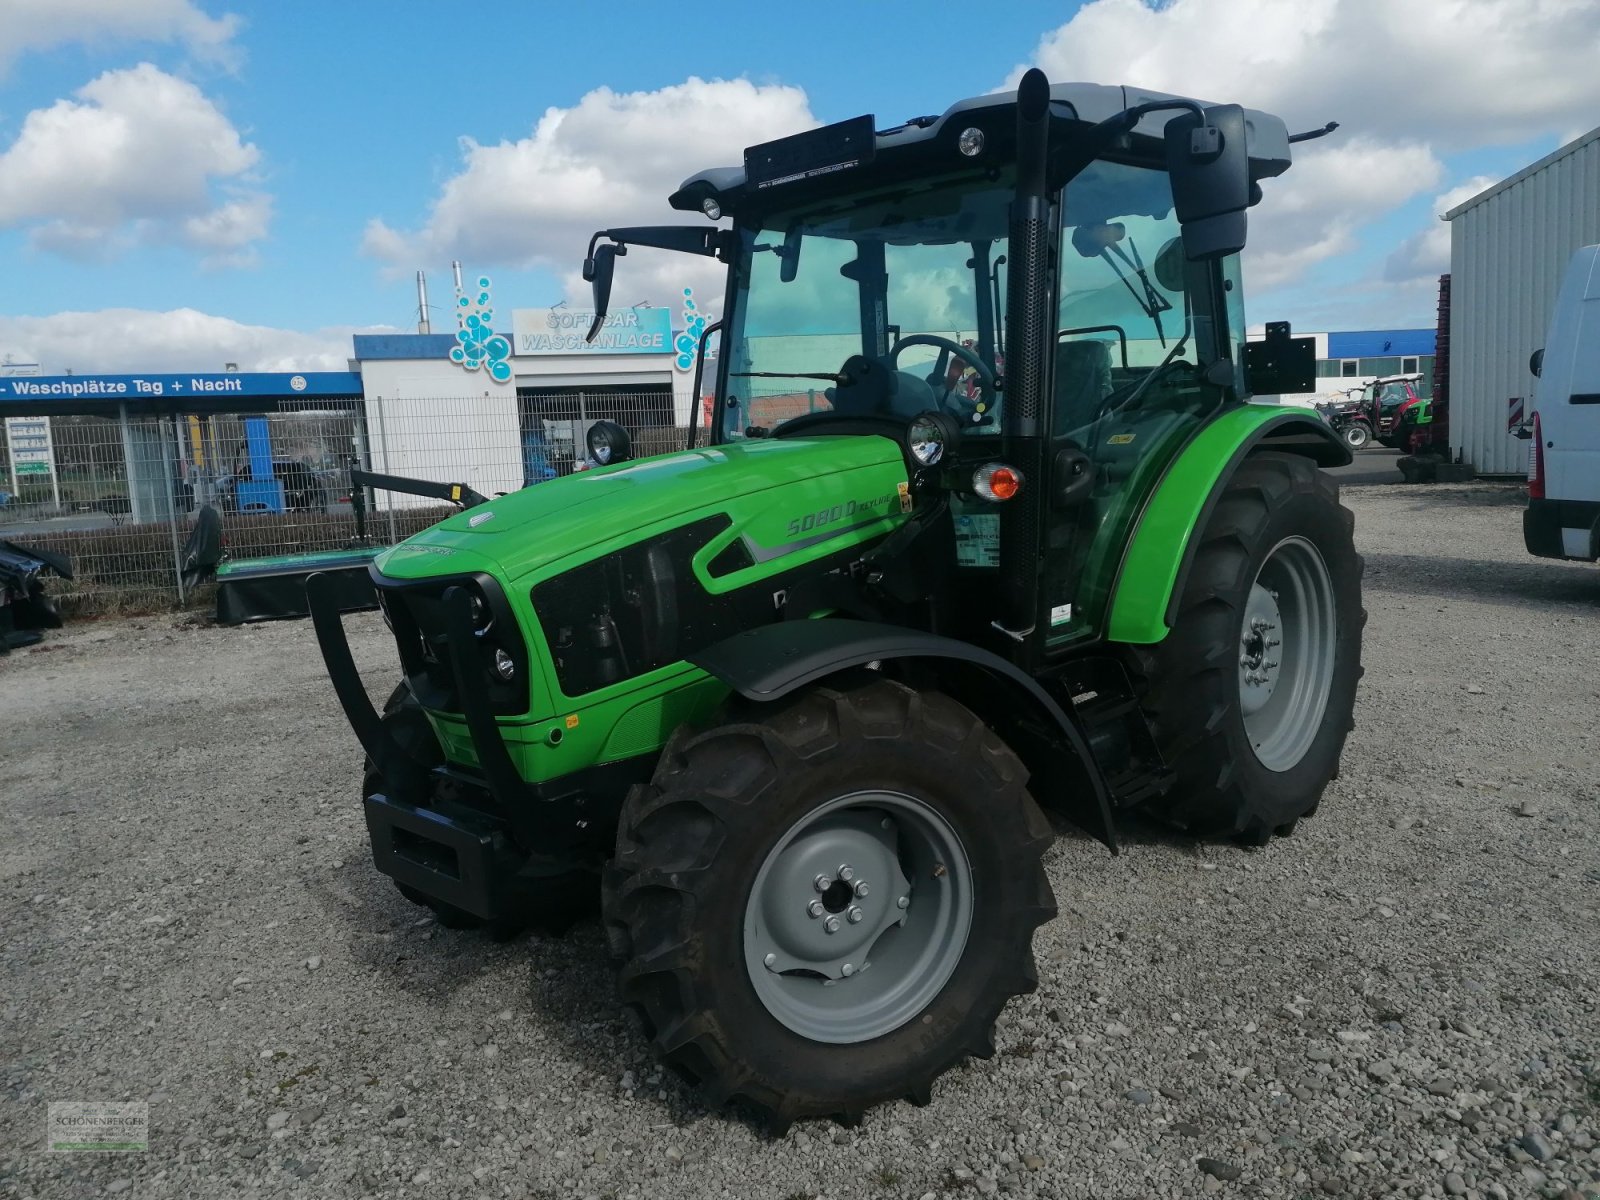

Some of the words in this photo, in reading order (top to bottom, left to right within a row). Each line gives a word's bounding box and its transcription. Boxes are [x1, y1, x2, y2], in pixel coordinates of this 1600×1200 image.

[547, 313, 594, 328] SOFT
[603, 312, 638, 327] CAR
[522, 333, 663, 350] WASCHANLAGE
[13, 380, 127, 395] Waschplätze
[133, 379, 163, 394] Tag
[191, 377, 242, 392] Nacht
